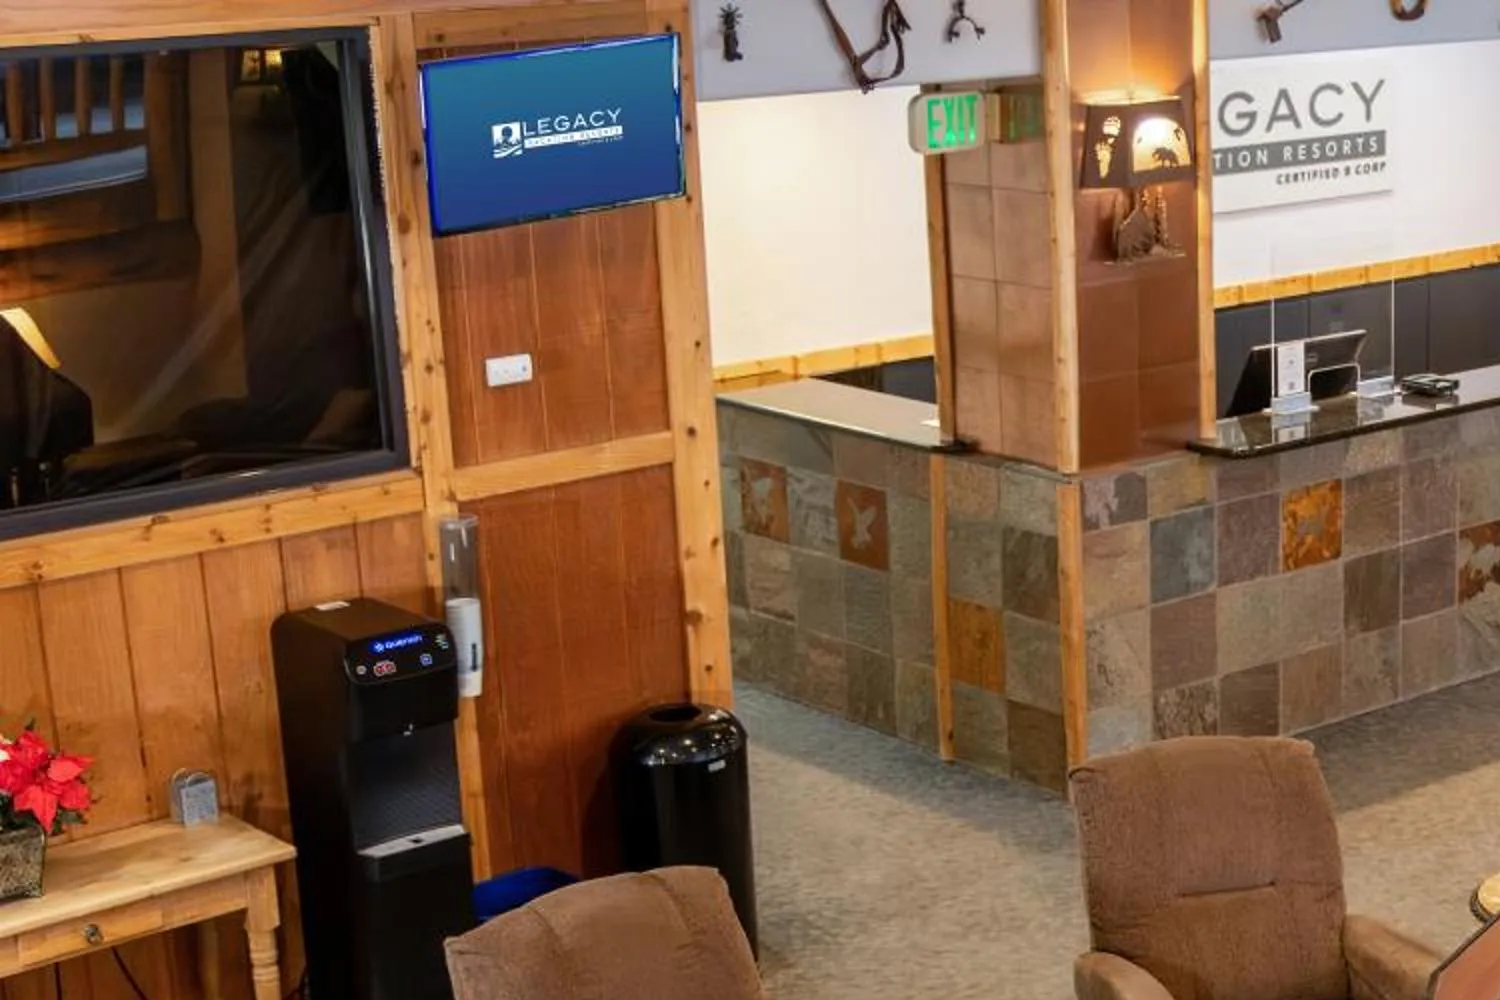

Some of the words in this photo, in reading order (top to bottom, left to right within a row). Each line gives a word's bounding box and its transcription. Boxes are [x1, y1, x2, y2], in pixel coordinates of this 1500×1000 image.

[522, 107, 622, 136] LEGACY
[927, 94, 977, 149] EXIT
[1217, 79, 1385, 137] GACY
[1213, 148, 1268, 169] TION
[1283, 136, 1378, 161] RESORTS
[1276, 167, 1339, 185] CERTIFIED
[1355, 161, 1386, 175] CORP
